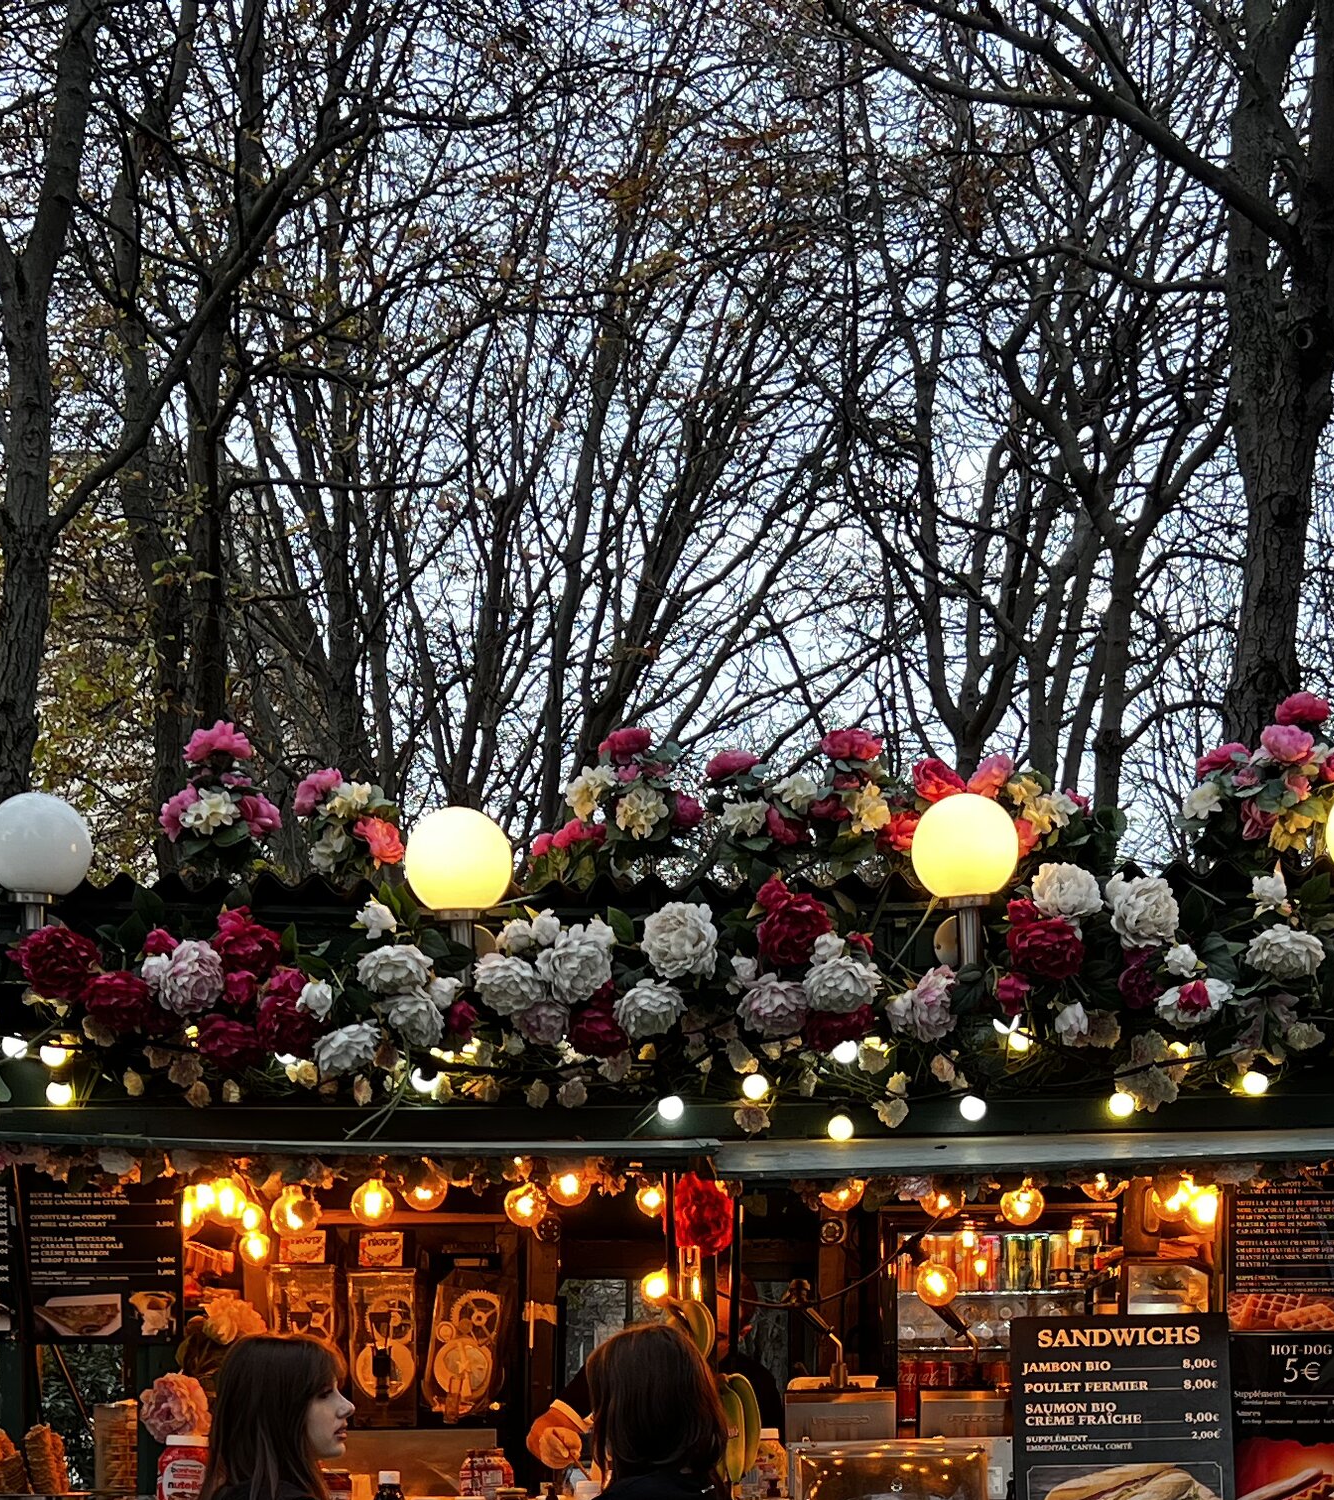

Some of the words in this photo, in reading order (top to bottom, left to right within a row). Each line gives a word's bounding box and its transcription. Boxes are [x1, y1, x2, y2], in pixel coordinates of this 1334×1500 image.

[1038, 1326, 1200, 1348] SANDWICHS
[1271, 1344, 1333, 1355] HOT-DOG
[1021, 1362, 1081, 1375] JAMBON
[1086, 1361, 1111, 1371] BIO
[1183, 1359, 1217, 1370] 8,00€
[1284, 1358, 1321, 1382] 5€
[1024, 1382, 1081, 1393] POULET
[1085, 1381, 1148, 1392] FERMIER
[1183, 1379, 1217, 1391] 8,00€
[1026, 1403, 1087, 1414] SAUMON
[1091, 1402, 1116, 1413] BIO
[1026, 1414, 1075, 1426] CRÈME
[1078, 1412, 1142, 1425] FRAÎCHE
[1185, 1412, 1219, 1424] 8,00€
[1026, 1433, 1088, 1443] SUPPLÉMENT
[1192, 1430, 1221, 1440] 2,00€
